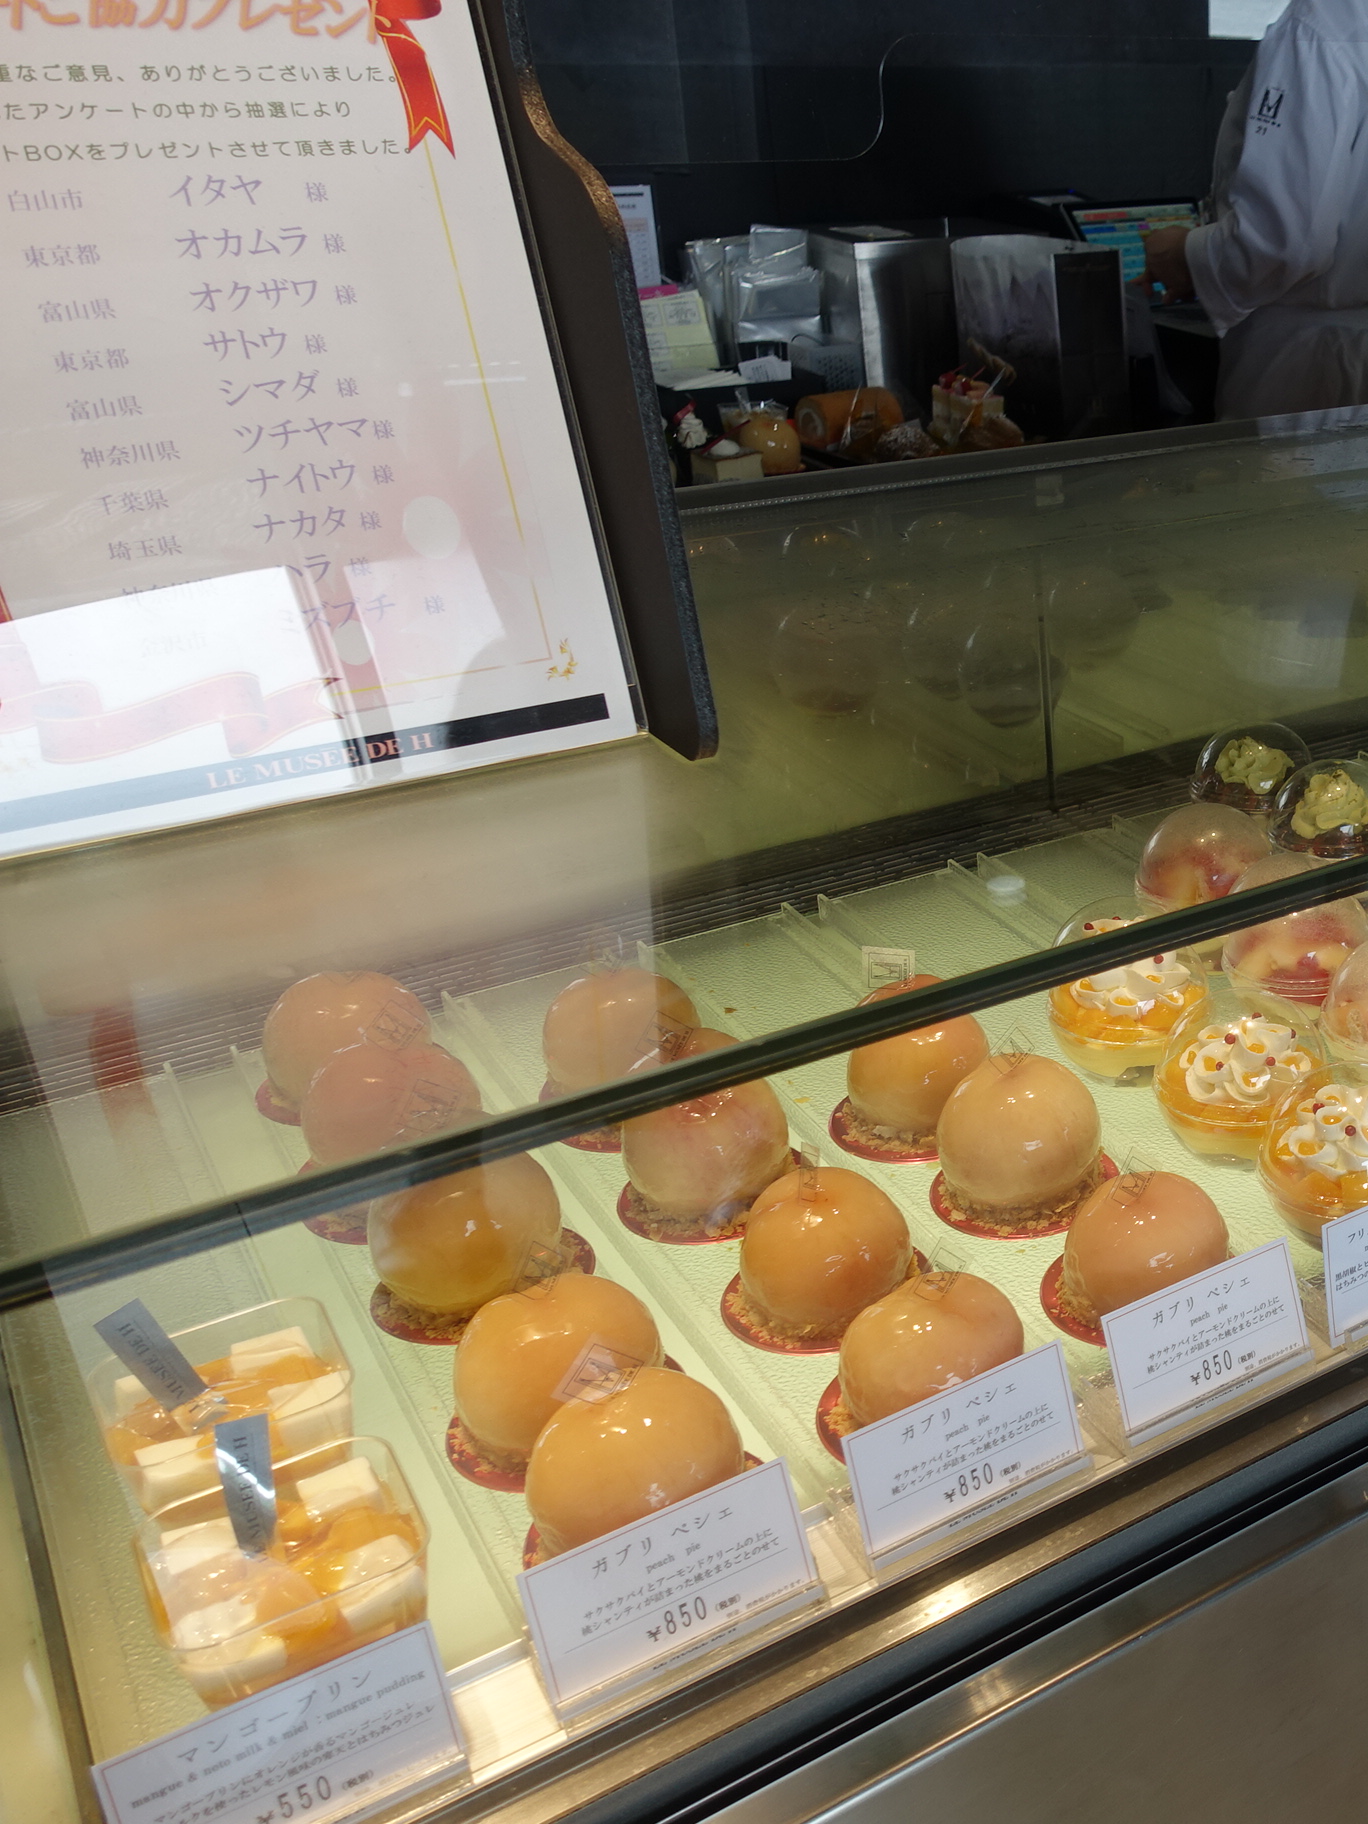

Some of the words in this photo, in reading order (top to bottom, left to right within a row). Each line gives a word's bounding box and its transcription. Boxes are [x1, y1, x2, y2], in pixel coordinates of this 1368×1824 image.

[0, 101, 352, 119] たアンケートの中から抽選により
[7, 188, 84, 213] 白山市
[168, 173, 263, 207] イタヤ
[305, 181, 329, 203] 様
[22, 242, 101, 269] 東京都
[175, 226, 308, 260] オカムラ
[324, 232, 347, 255] 様
[37, 297, 117, 323] 富山県
[189, 278, 318, 312] オクザワ
[334, 283, 358, 306] 様
[53, 347, 130, 374] 東京都
[202, 326, 288, 361] サトウ
[305, 333, 328, 356] 様
[65, 395, 143, 422] 富山県
[218, 368, 320, 406] シマダ
[336, 376, 360, 399] 様
[79, 439, 182, 470] 神奈川県
[233, 416, 370, 454] ツチヤマ
[373, 418, 396, 440] 様
[97, 488, 170, 517] 千葉県
[246, 458, 357, 498] ナイトウ
[373, 463, 395, 485] 様
[107, 534, 183, 562] 埼玉県
[252, 505, 347, 544] ナカタ
[359, 510, 383, 531] 様
[349, 556, 373, 578] 様
[424, 594, 446, 617] 様
[206, 768, 246, 789] LE
[366, 738, 404, 760] DE
[410, 732, 435, 751] H
[1148, 1295, 1281, 1361] サクサクパイとアーモンドクリームの上に
[1152, 1296, 1195, 1329] ガブリ
[1190, 1310, 1211, 1327] peach
[1217, 1302, 1229, 1315] pie
[1190, 1349, 1233, 1387] ¥850
[893, 1402, 1049, 1482] サクサクパイとアーモンドクリームの上に
[901, 1407, 952, 1445] ガブリ
[944, 1423, 970, 1443] peach
[977, 1413, 991, 1428] pie
[943, 1462, 995, 1504] ¥850
[582, 1527, 774, 1621] サクサクパイとアーモンドクリームの上に
[592, 1536, 655, 1580] ガブリ
[645, 1552, 676, 1576] peach
[685, 1541, 702, 1558] pie
[645, 1596, 709, 1643] ¥850
[177, 1669, 373, 1764] マンゴープリン
[130, 1778, 184, 1811] mangue
[187, 1771, 198, 1785] &
[203, 1758, 232, 1779] noto
[235, 1743, 263, 1770] milk
[266, 1736, 279, 1750] &
[281, 1720, 310, 1742] miel
[325, 1690, 374, 1722] mangue
[376, 1668, 426, 1700] pudding
[256, 1774, 333, 1824] ¥550
